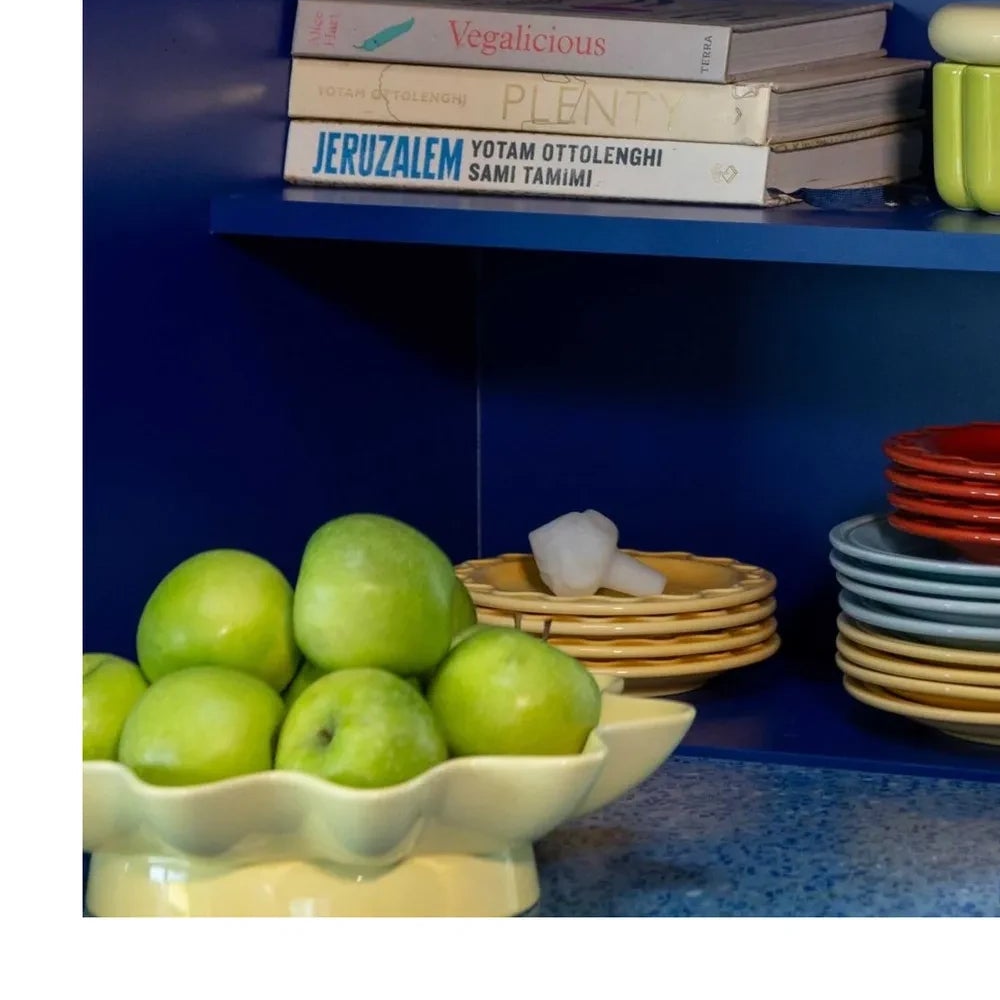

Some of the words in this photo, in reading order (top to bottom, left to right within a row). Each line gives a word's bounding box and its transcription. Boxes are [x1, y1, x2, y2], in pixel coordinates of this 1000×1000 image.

[448, 19, 607, 56] Vegalicious
[700, 35, 713, 74] TERRA
[317, 86, 366, 99] YOTAM
[371, 89, 467, 106] OTTOLENGHI
[501, 83, 682, 131] PLENTY
[312, 131, 464, 182] JERUZALEM
[472, 139, 536, 161] YOTAM
[542, 143, 664, 167] OTTOLENGHI
[468, 163, 516, 184] SAMI
